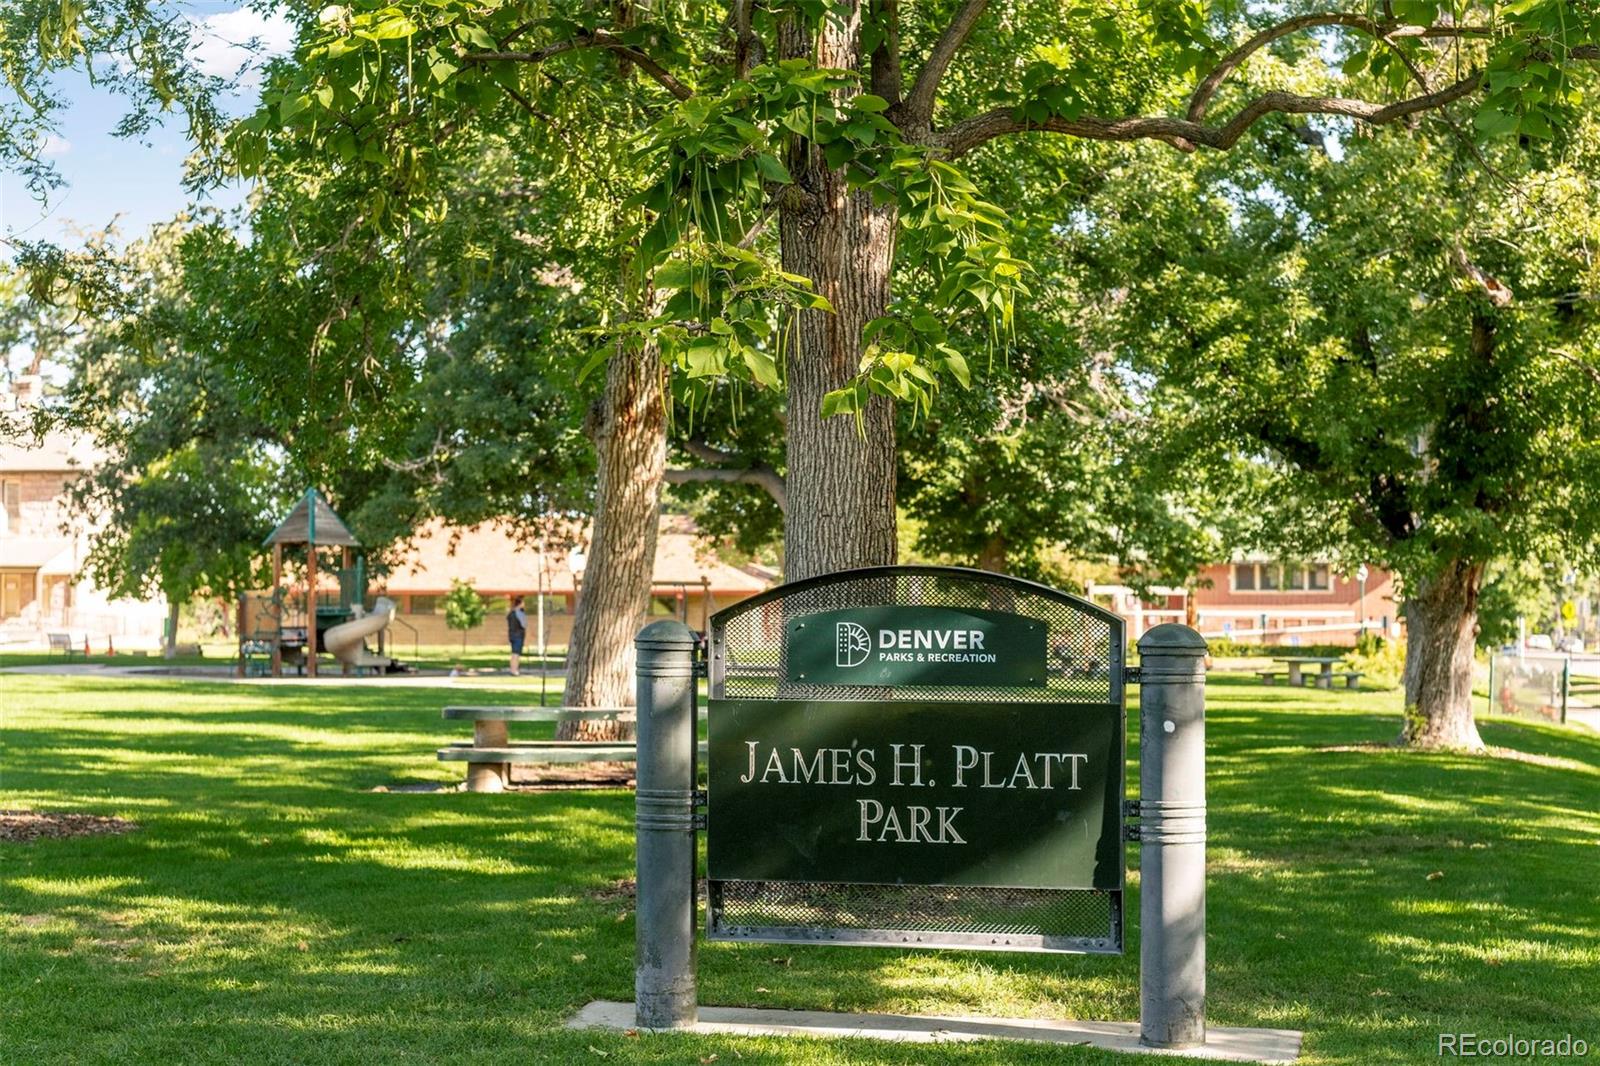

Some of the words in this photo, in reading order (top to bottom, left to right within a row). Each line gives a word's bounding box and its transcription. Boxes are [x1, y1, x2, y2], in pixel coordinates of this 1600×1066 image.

[879, 629, 985, 650] DENVER
[879, 652, 914, 662] PARKS
[916, 652, 925, 663] &
[928, 653, 997, 663] RECREATION
[740, 740, 877, 786] JAMES
[888, 744, 937, 787] H.
[951, 745, 1088, 790] PLATT
[856, 799, 968, 844] PARK
